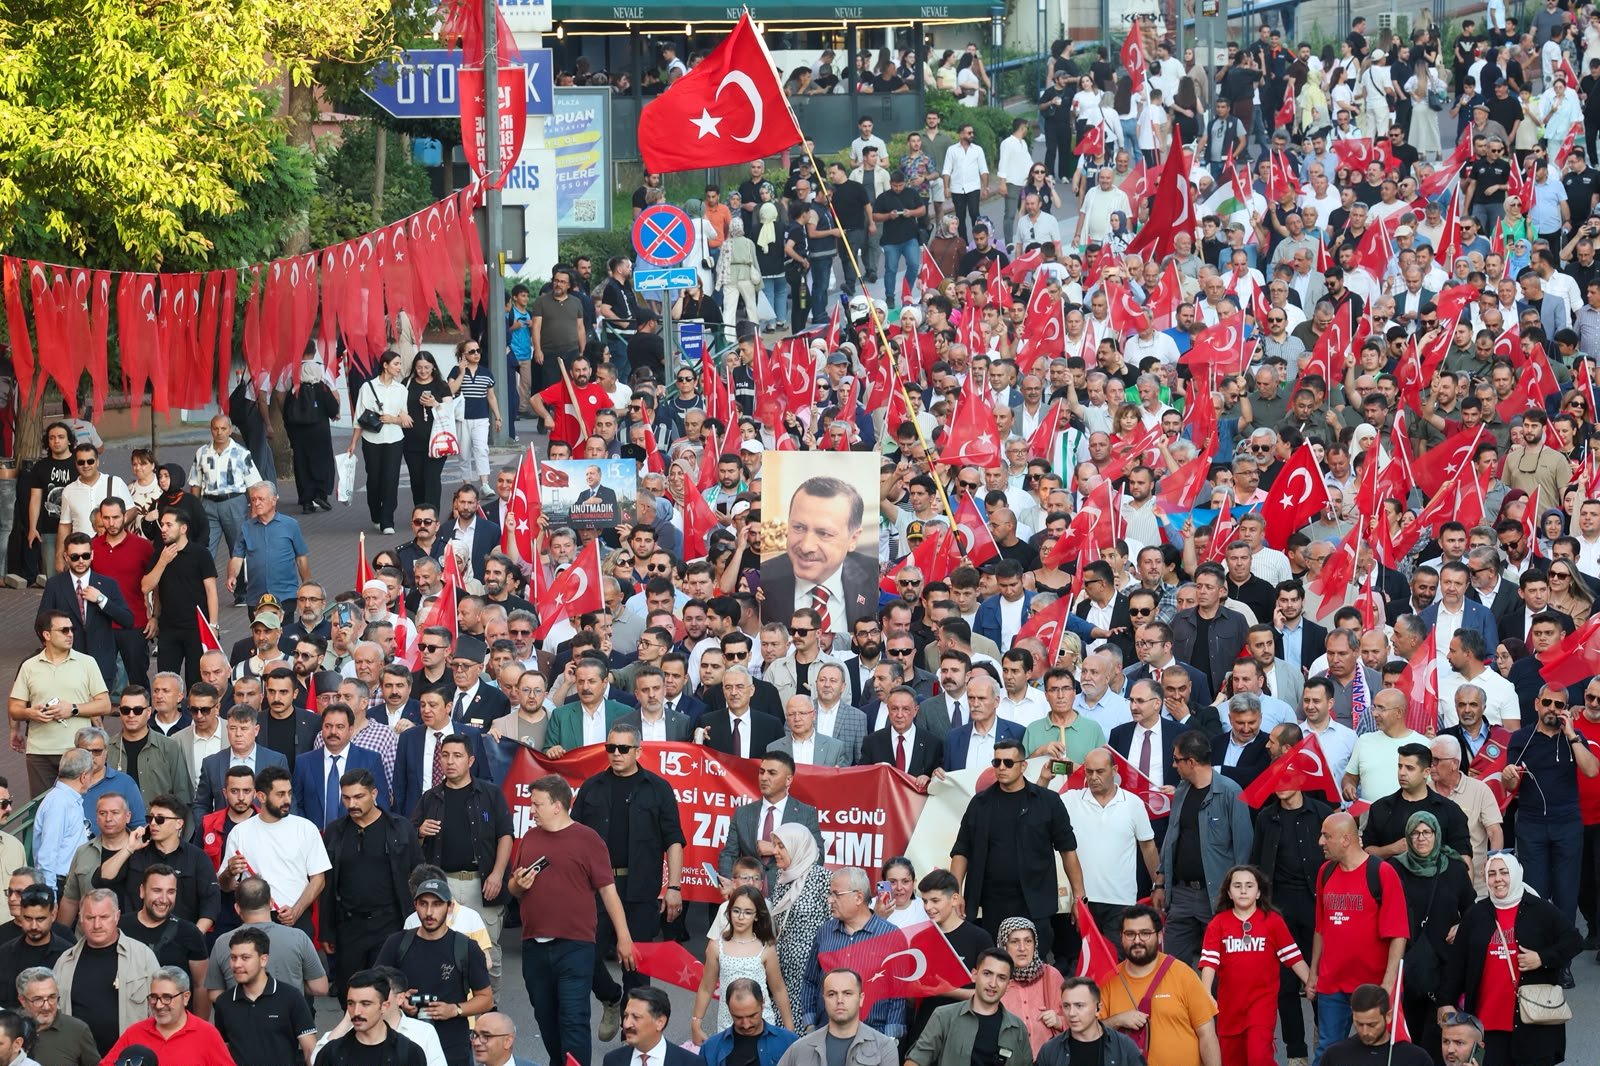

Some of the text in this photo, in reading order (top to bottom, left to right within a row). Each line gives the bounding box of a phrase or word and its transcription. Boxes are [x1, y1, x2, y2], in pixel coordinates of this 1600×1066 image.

[613, 7, 644, 19] NEVALE
[726, 7, 756, 19] NEVE
[834, 7, 863, 18] NEVALE
[921, 6, 948, 18] NEVALE
[397, 63, 541, 104] OTOK
[555, 109, 595, 125] PUAN
[504, 161, 539, 190] RİŞ
[515, 783, 532, 798] 15
[702, 791, 726, 807] VE
[835, 807, 886, 826] GÜNÜ
[820, 830, 884, 868] ZİM!
[681, 867, 699, 875] RKİYE
[680, 876, 703, 886] URSA
